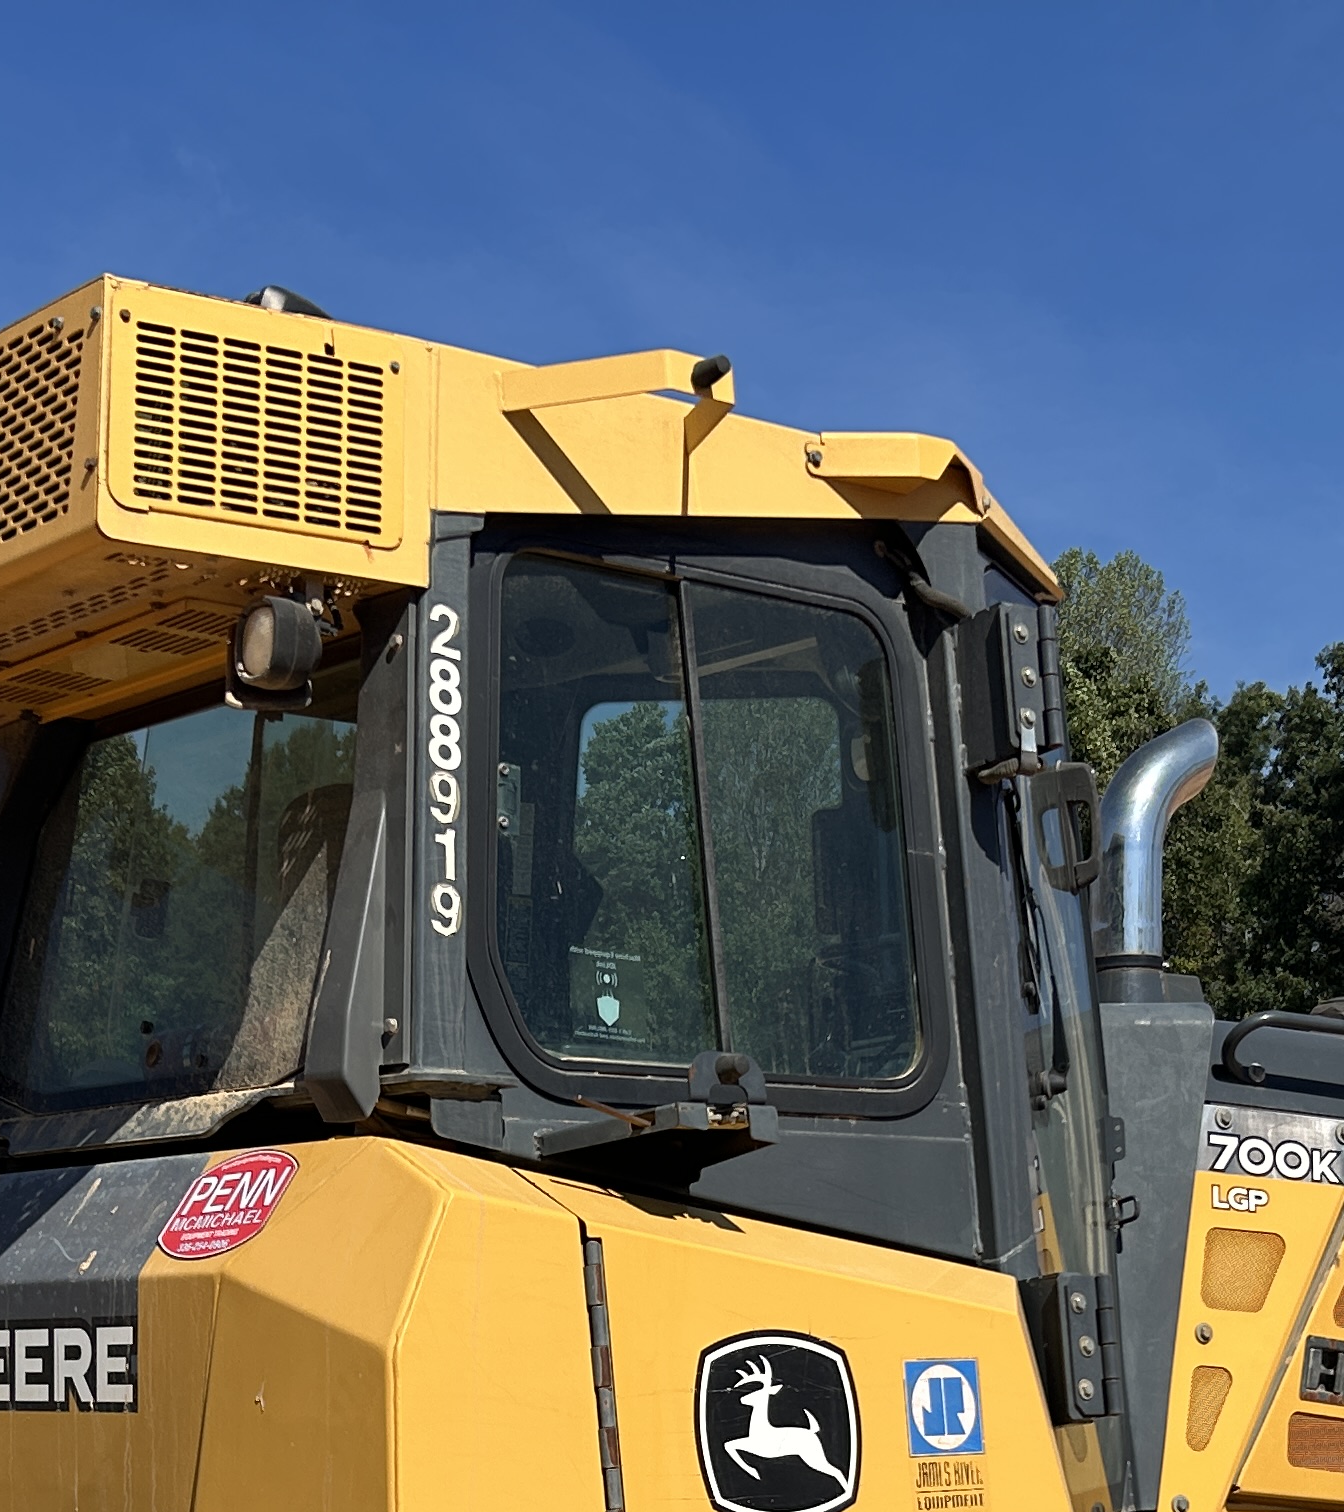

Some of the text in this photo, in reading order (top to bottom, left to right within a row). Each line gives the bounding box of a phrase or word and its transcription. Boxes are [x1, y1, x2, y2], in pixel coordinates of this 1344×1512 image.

[429, 604, 462, 937] 288919
[1208, 1132, 1344, 1185] 700K
[181, 1166, 292, 1216] PENN
[1211, 1185, 1269, 1212] LGP
[170, 1208, 263, 1232] MCMICHAEL
